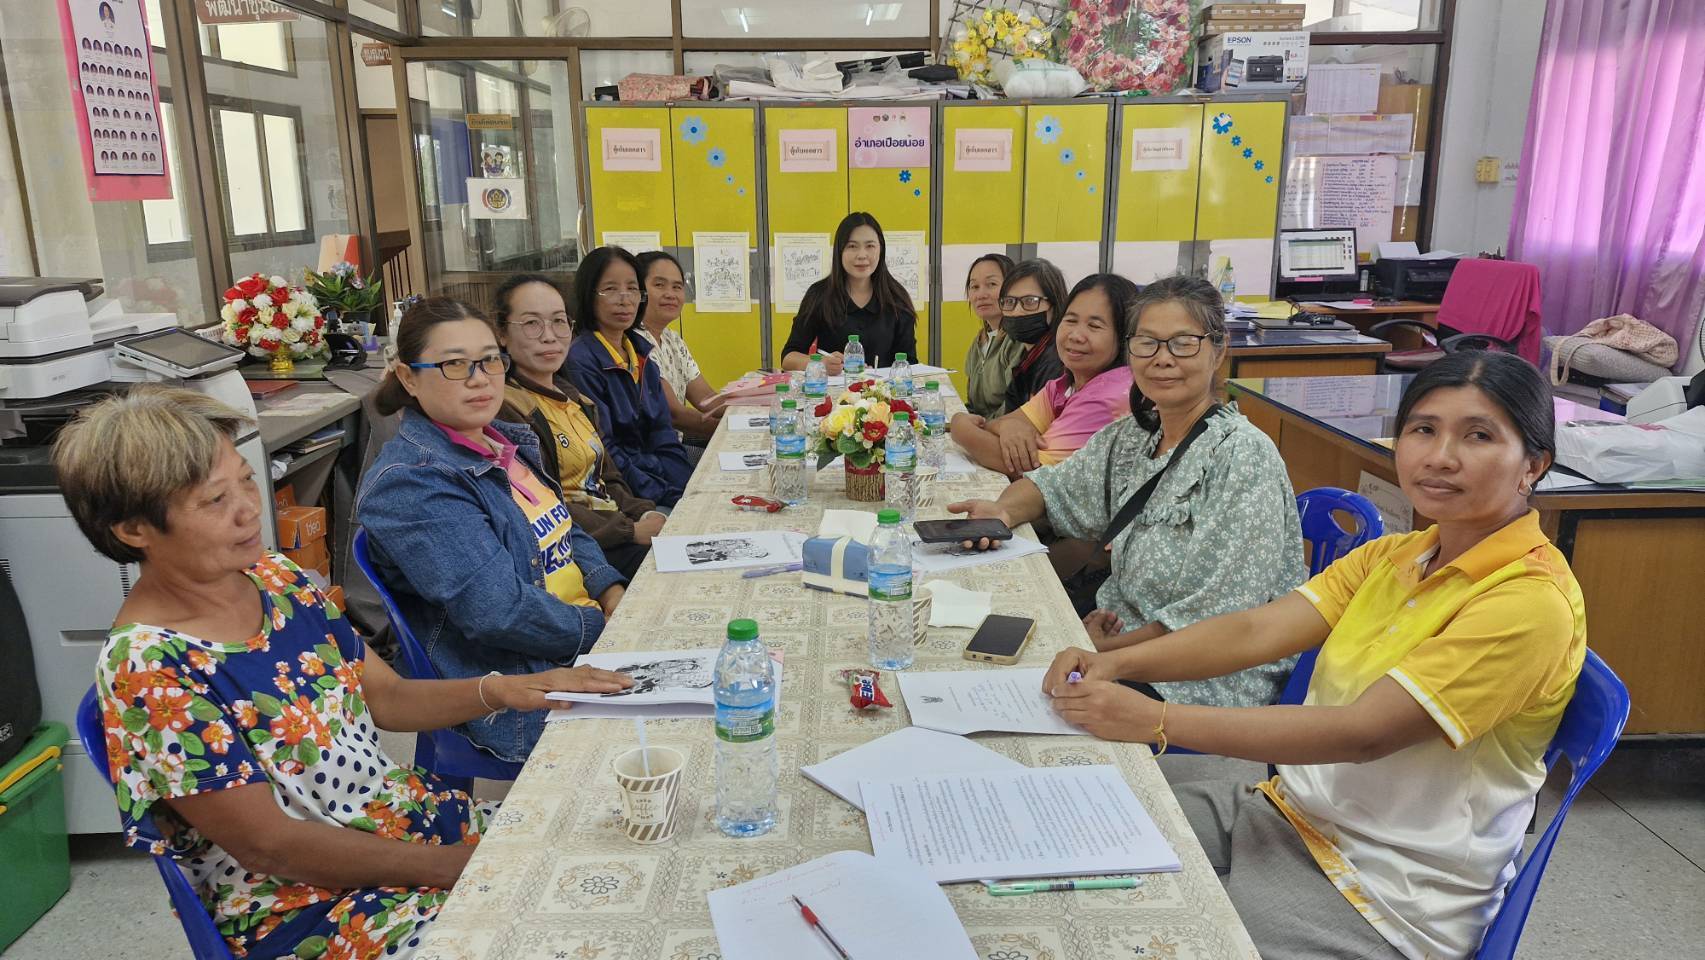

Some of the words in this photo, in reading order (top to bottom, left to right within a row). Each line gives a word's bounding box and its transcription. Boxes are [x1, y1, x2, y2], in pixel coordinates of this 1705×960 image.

[1227, 36, 1252, 44] EPSON
[854, 133, 925, 148] อำเภอเปือยน้อย
[531, 513, 555, 538] UN
